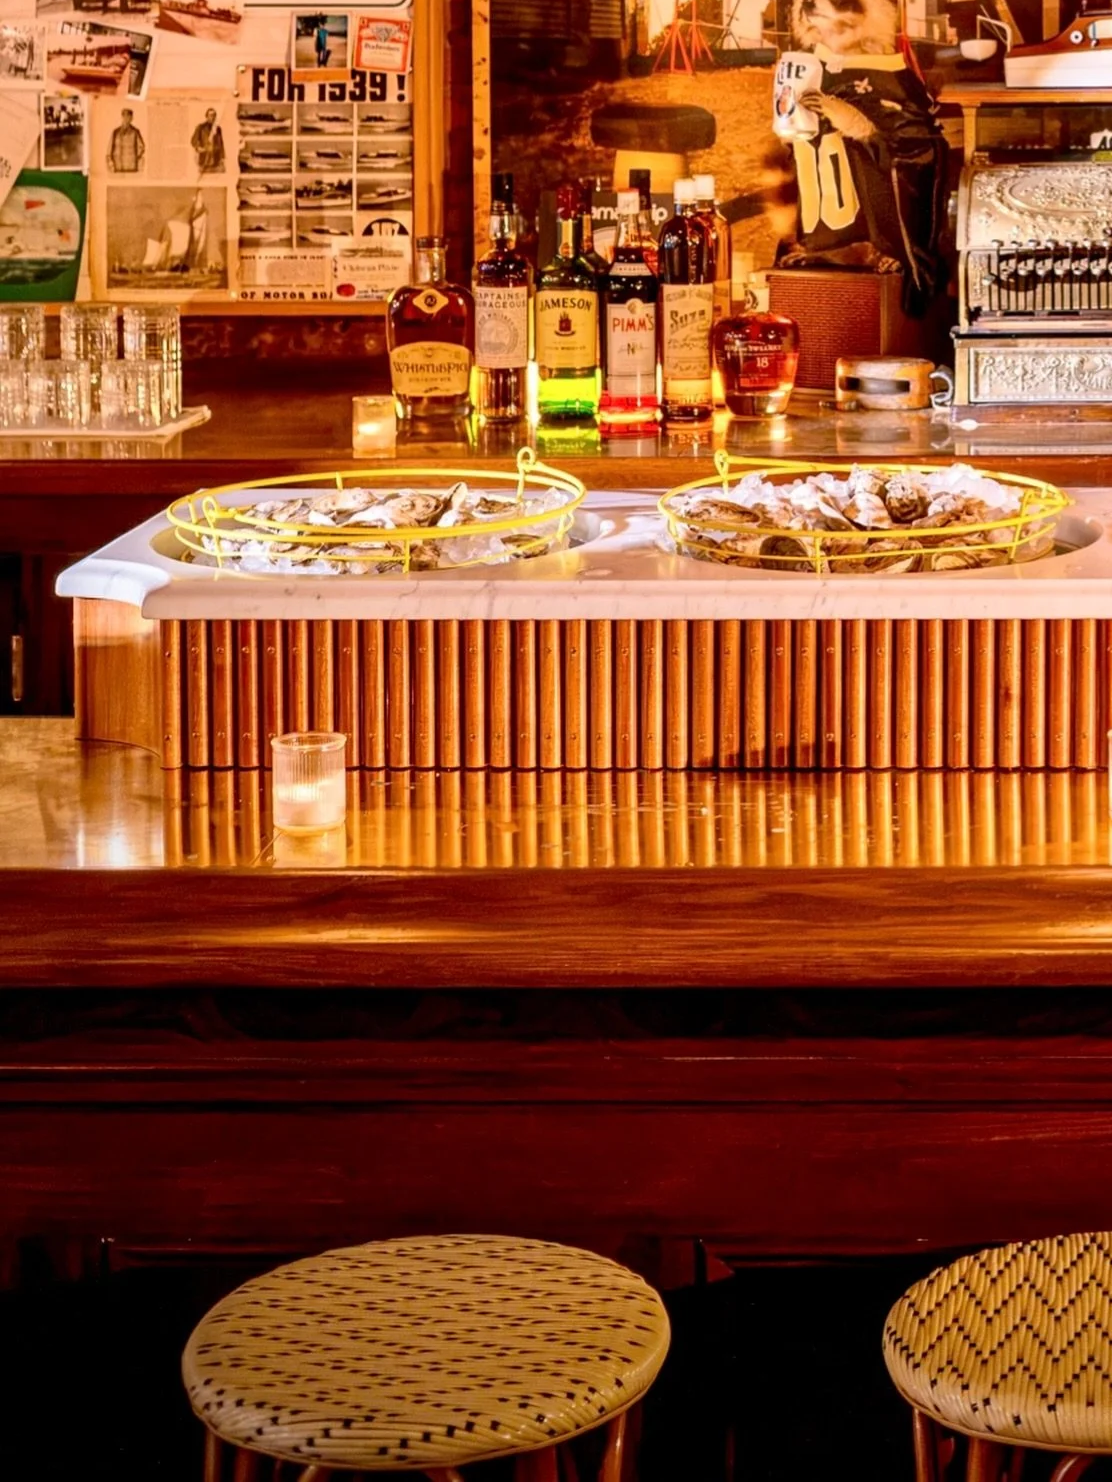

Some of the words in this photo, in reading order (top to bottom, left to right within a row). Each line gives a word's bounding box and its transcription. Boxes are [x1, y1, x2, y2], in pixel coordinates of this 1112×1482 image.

[793, 131, 860, 234] 10
[240, 291, 257, 300] OF
[263, 291, 306, 300] MOTOR
[539, 297, 592, 312] JAMESON
[612, 313, 655, 332] PIMM'S
[756, 356, 769, 368] 18
